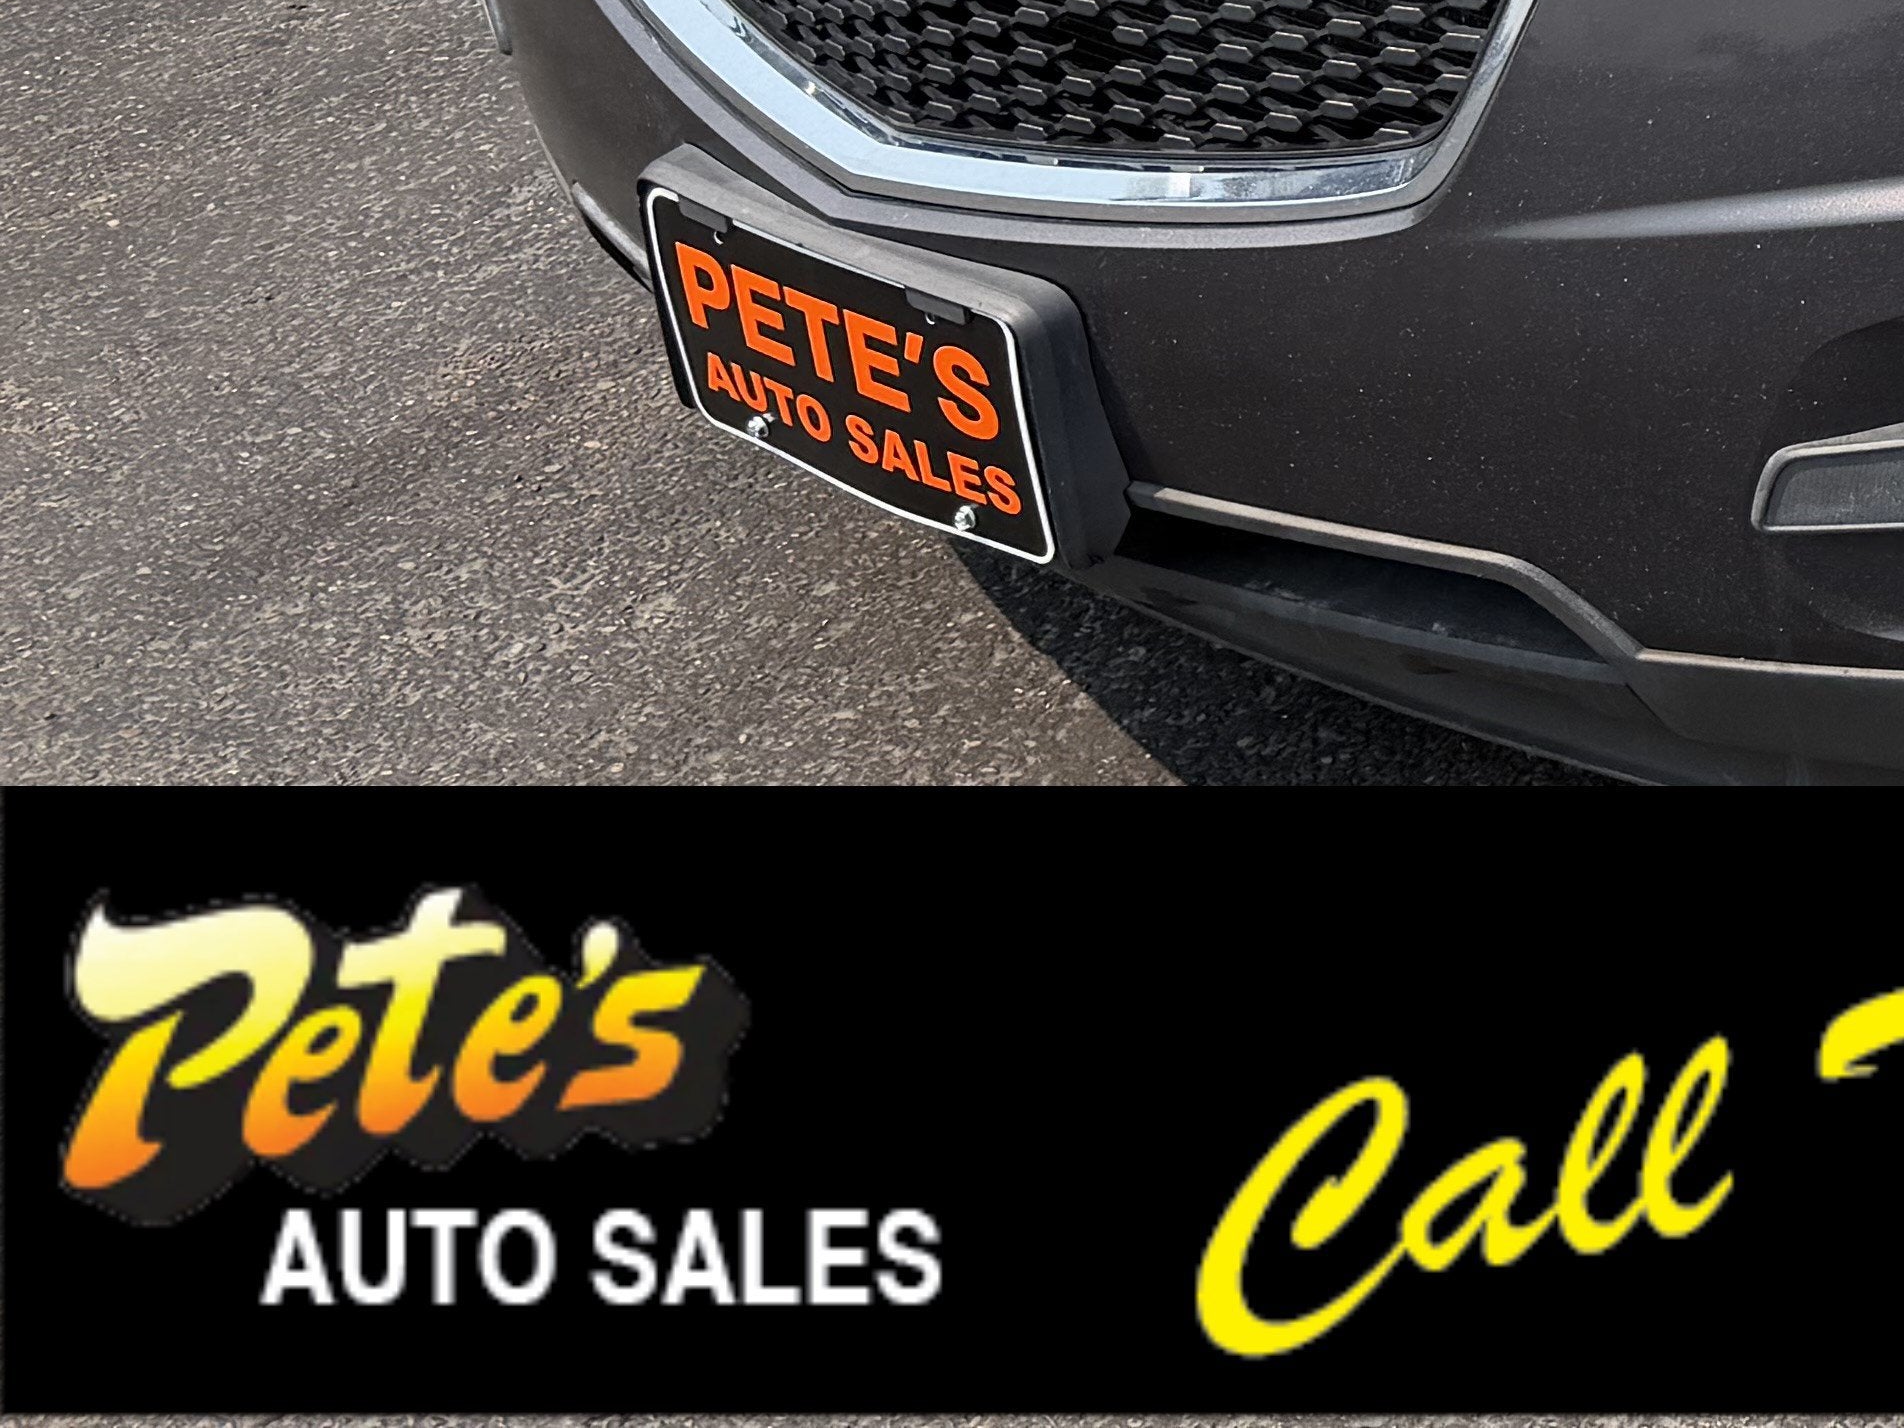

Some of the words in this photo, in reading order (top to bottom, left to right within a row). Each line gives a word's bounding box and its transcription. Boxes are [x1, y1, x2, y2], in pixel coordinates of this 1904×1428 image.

[675, 241, 999, 441] PETE'S
[706, 351, 832, 444] AUTO
[844, 413, 1022, 516] SALES
